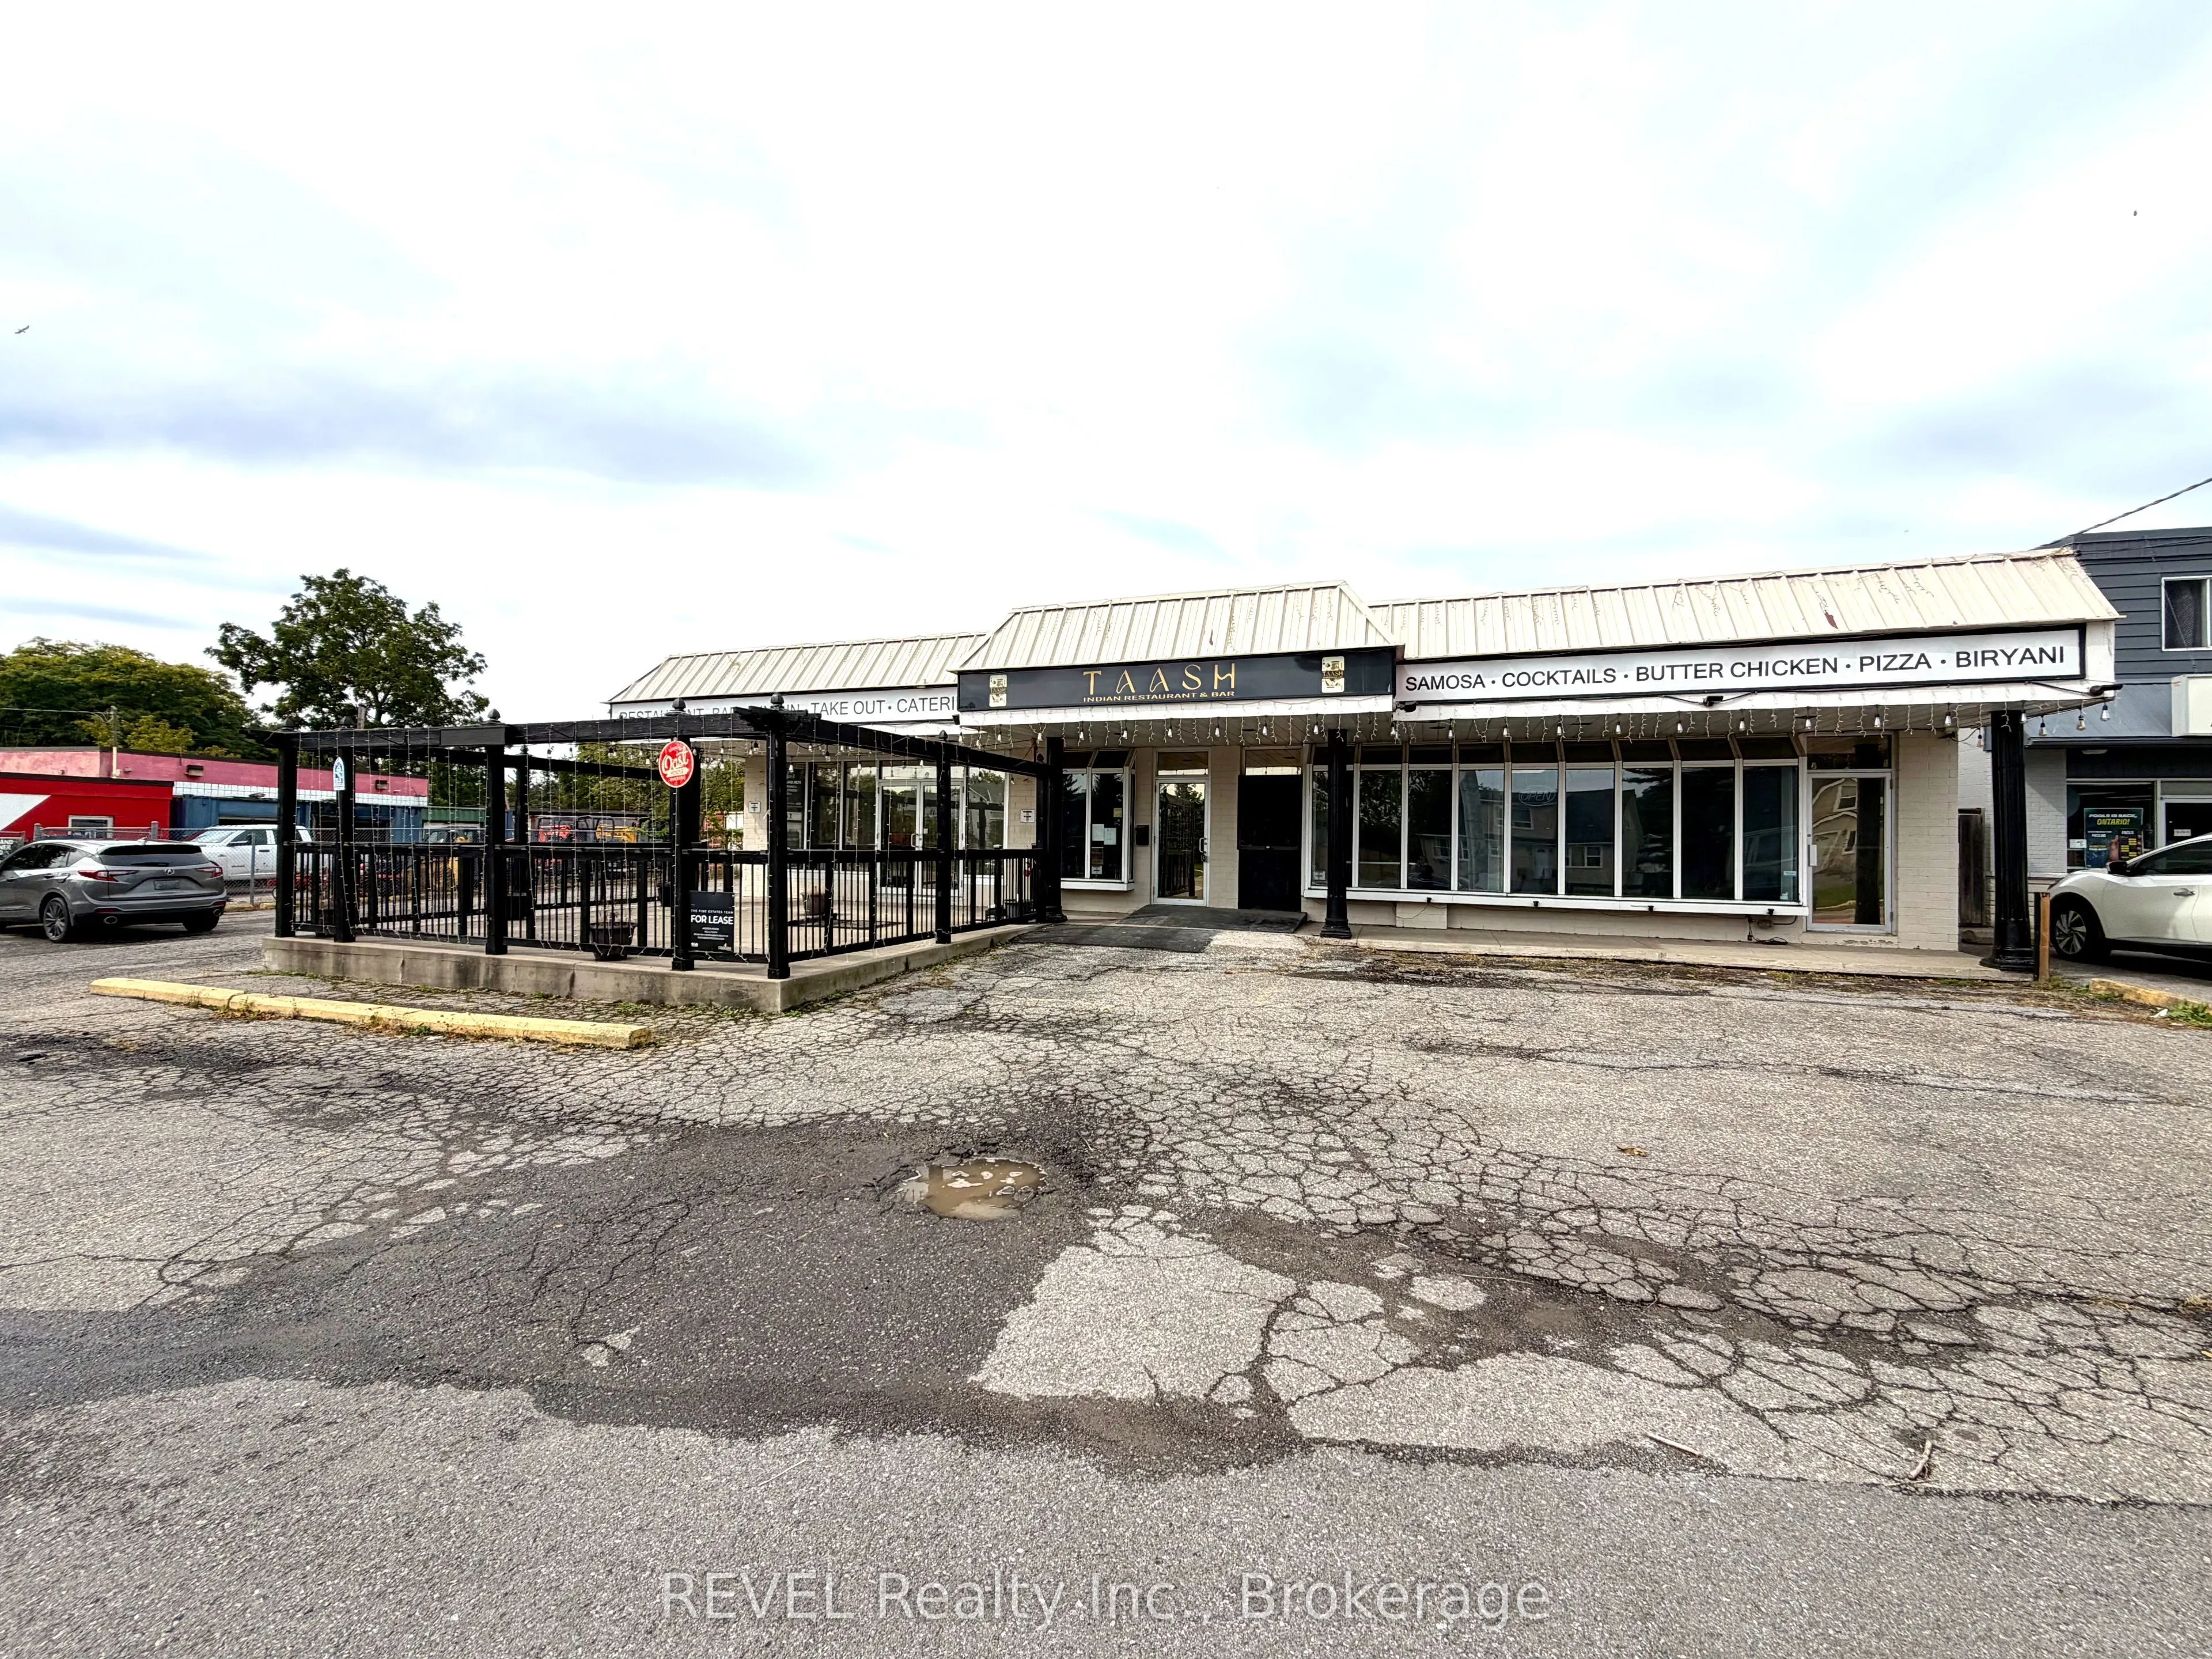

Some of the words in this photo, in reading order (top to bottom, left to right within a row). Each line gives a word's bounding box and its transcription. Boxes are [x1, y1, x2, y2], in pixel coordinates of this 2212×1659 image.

[1405, 673, 1486, 691] SAMOSA
[1502, 668, 1616, 688] COCKTAILS
[1636, 662, 1724, 681] BUTTER
[1730, 657, 1838, 677] CHICKEN
[1859, 653, 1932, 672] PIZZA
[1956, 646, 2064, 668] BIRYANI
[1082, 662, 1236, 695] TAASH
[1124, 692, 1197, 701] RESTAURANT
[810, 701, 849, 715] TAKE
[853, 699, 886, 714] OUT
[691, 914, 707, 923] FOR
[709, 915, 733, 925] LEASE
